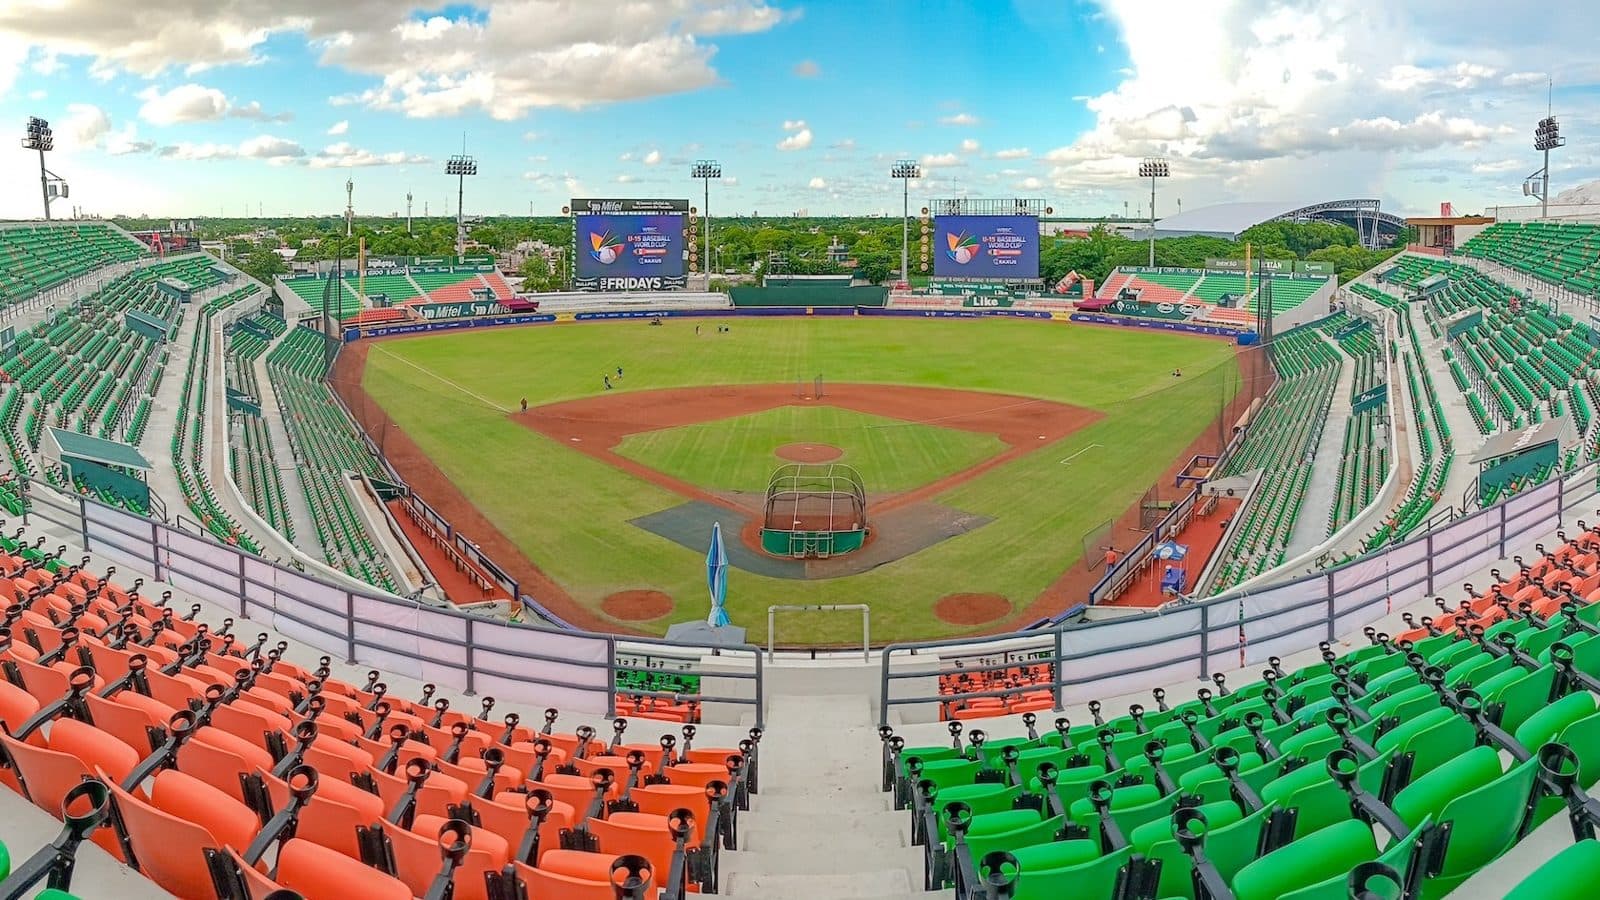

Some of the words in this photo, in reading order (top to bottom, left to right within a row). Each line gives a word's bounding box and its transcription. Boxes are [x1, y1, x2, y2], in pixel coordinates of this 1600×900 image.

[601, 201, 622, 211] Mifel
[607, 277, 661, 289] FRIDAYS
[973, 296, 998, 306] Like
[435, 305, 462, 318] Mifel
